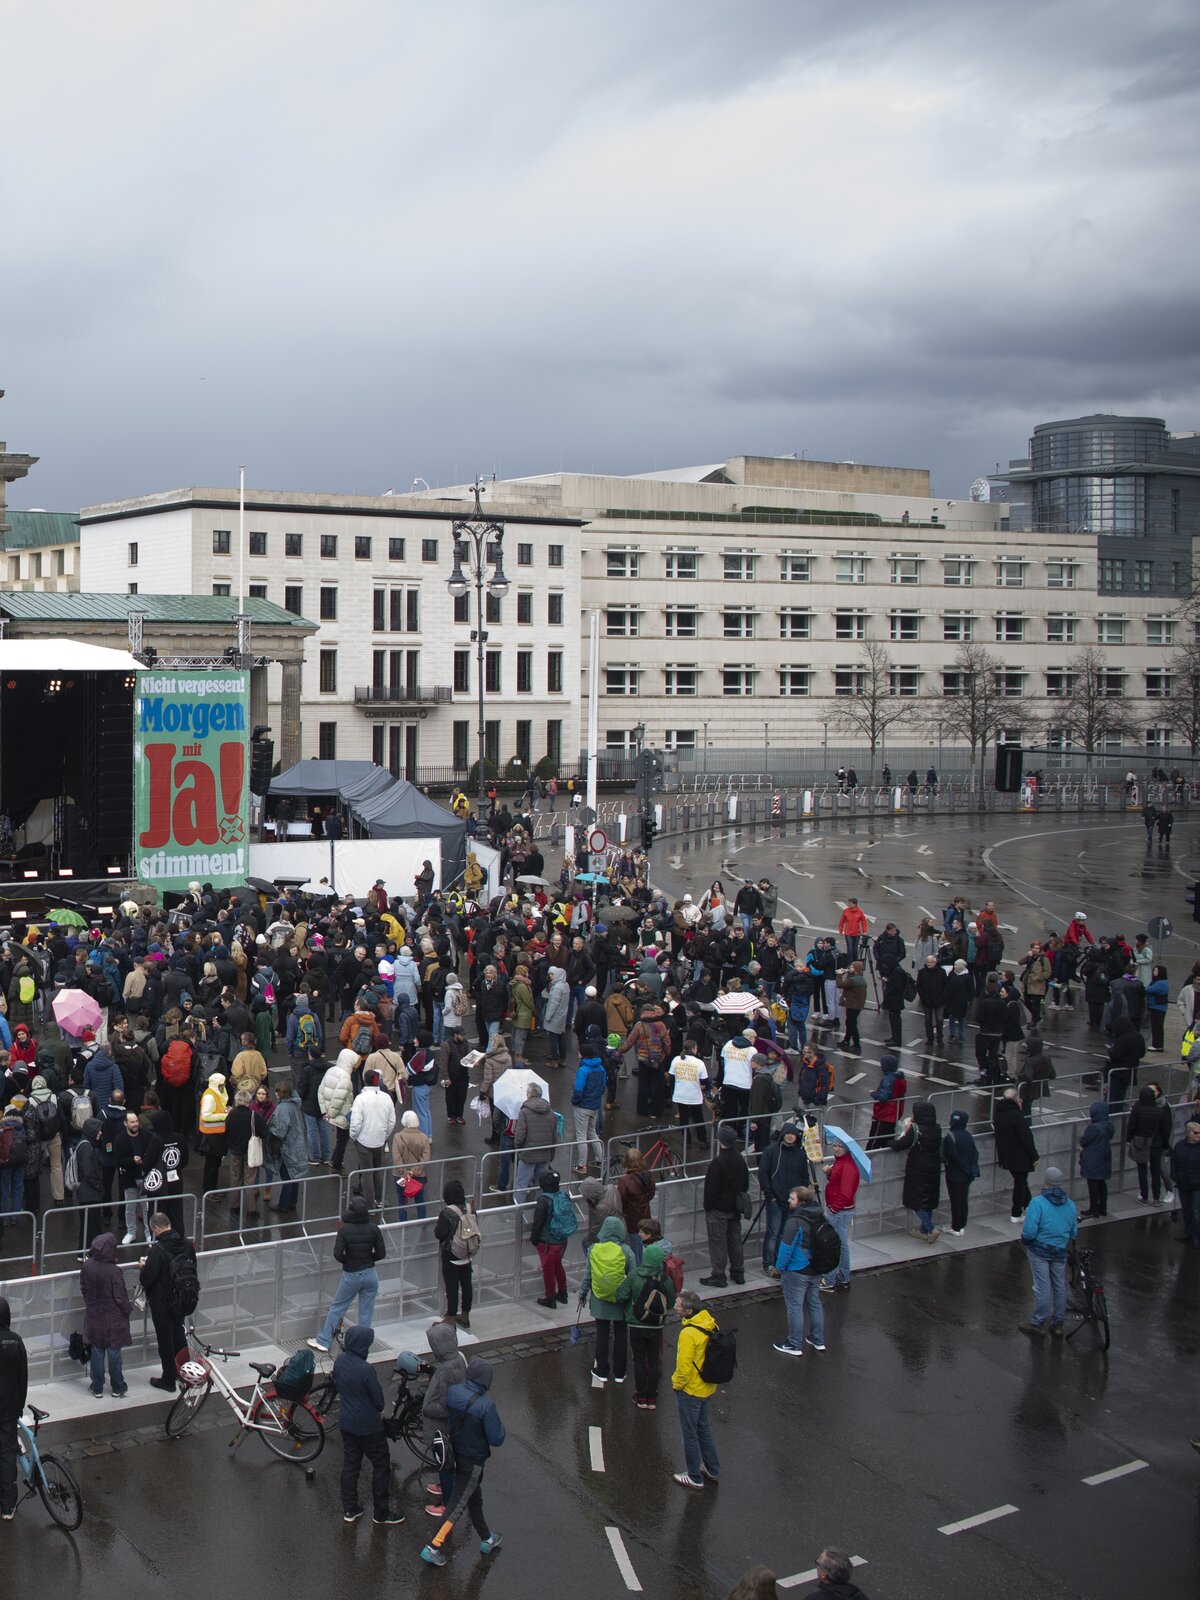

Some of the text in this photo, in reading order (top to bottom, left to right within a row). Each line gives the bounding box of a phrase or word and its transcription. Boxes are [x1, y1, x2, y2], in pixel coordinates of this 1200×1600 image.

[140, 676, 245, 696] Nicht vergessen!
[139, 697, 245, 739] Morgen
[182, 742, 202, 756] mit
[139, 742, 245, 848] Ja!
[139, 848, 245, 879] stimmen!
